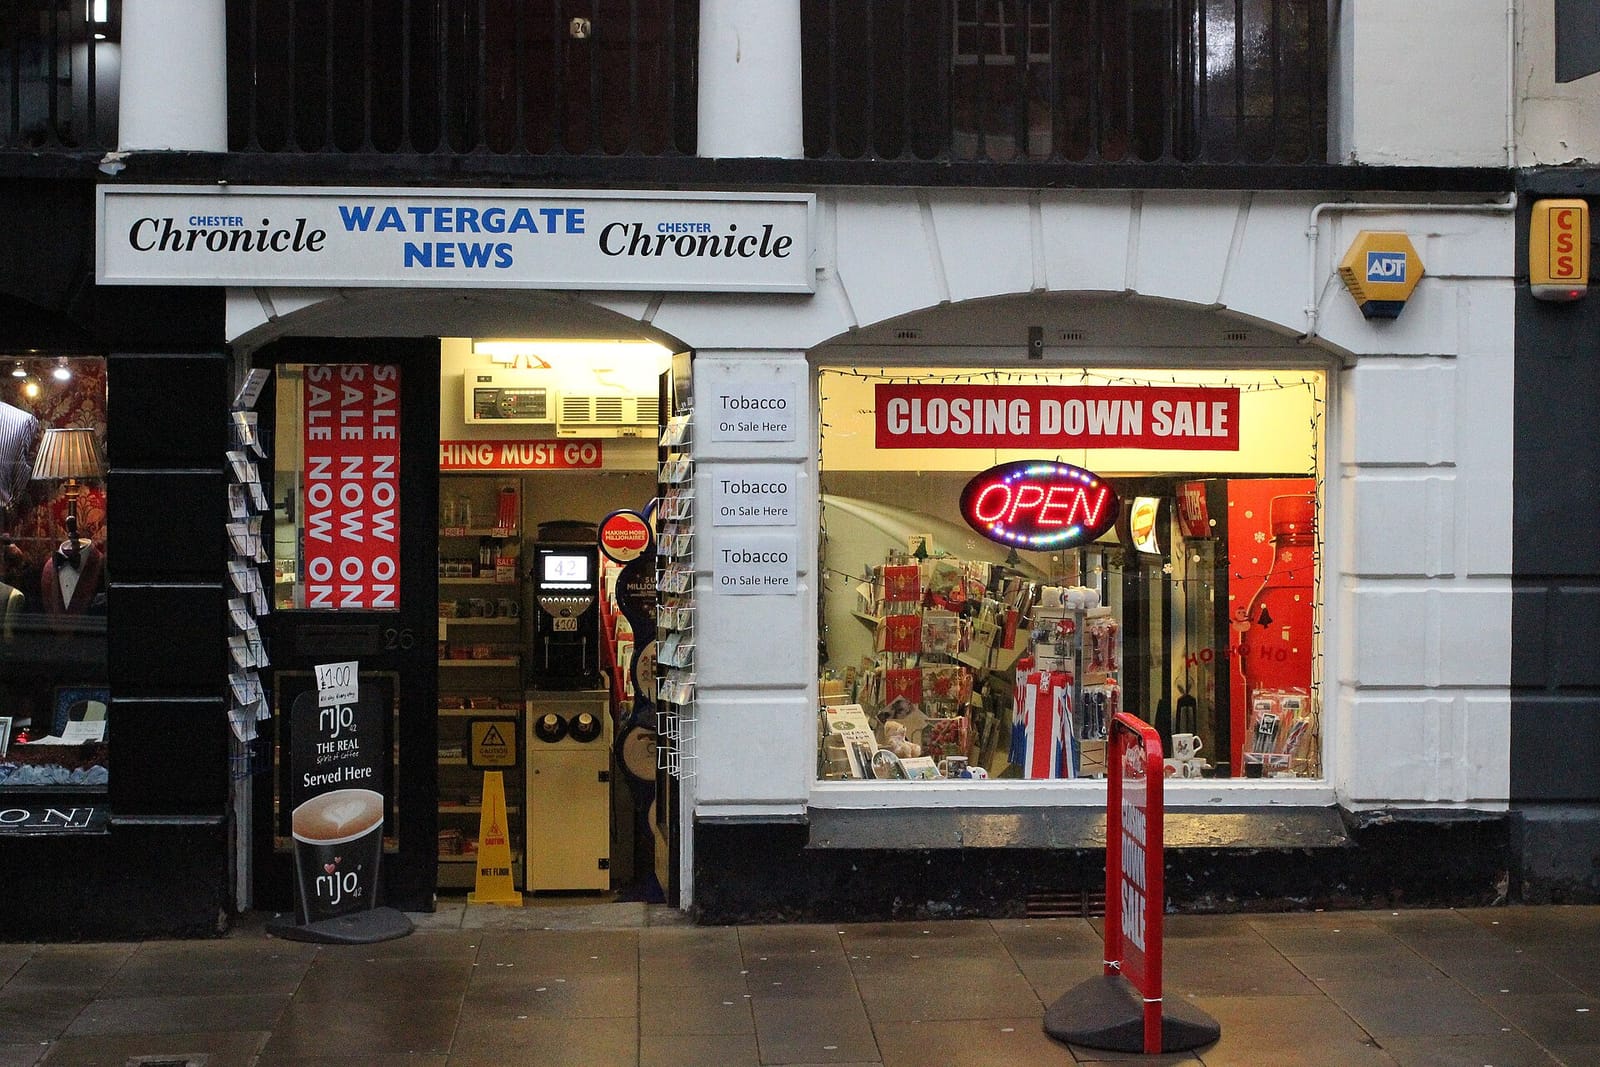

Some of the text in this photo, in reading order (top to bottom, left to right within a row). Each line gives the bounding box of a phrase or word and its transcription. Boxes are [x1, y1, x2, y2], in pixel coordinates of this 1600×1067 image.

[189, 216, 244, 227] CHESTER
[338, 206, 584, 234] WATERGATE
[657, 222, 712, 233] CHESTER
[129, 217, 327, 252] Chronicle
[599, 221, 793, 258] Chronicle
[404, 242, 514, 269] NEWS
[1368, 258, 1405, 276] ADT
[720, 395, 787, 410] Tobacco
[719, 421, 787, 432] On Sale Here
[886, 397, 1228, 437] CLOSING DOWN SALE
[440, 443, 597, 465] HING MUST GO
[308, 366, 334, 607] SALE NOW ON
[340, 366, 364, 607] SALE NOW ON
[371, 365, 396, 607] SALE NOW ON
[721, 480, 788, 494] Tobacco
[720, 506, 788, 516] On Sale Here
[975, 484, 1106, 526] OPEN
[721, 549, 788, 563] Tobacco
[554, 560, 577, 576] 42
[721, 575, 789, 585] On Sale Here
[1185, 648, 1213, 668] HO
[1260, 644, 1286, 662] HO
[316, 738, 360, 754] THE REAL
[303, 766, 372, 787] Served Here
[485, 837, 504, 845] CAUTION
[481, 868, 492, 876] WET
[316, 871, 358, 905] rijo
[1121, 878, 1146, 953] SALE
